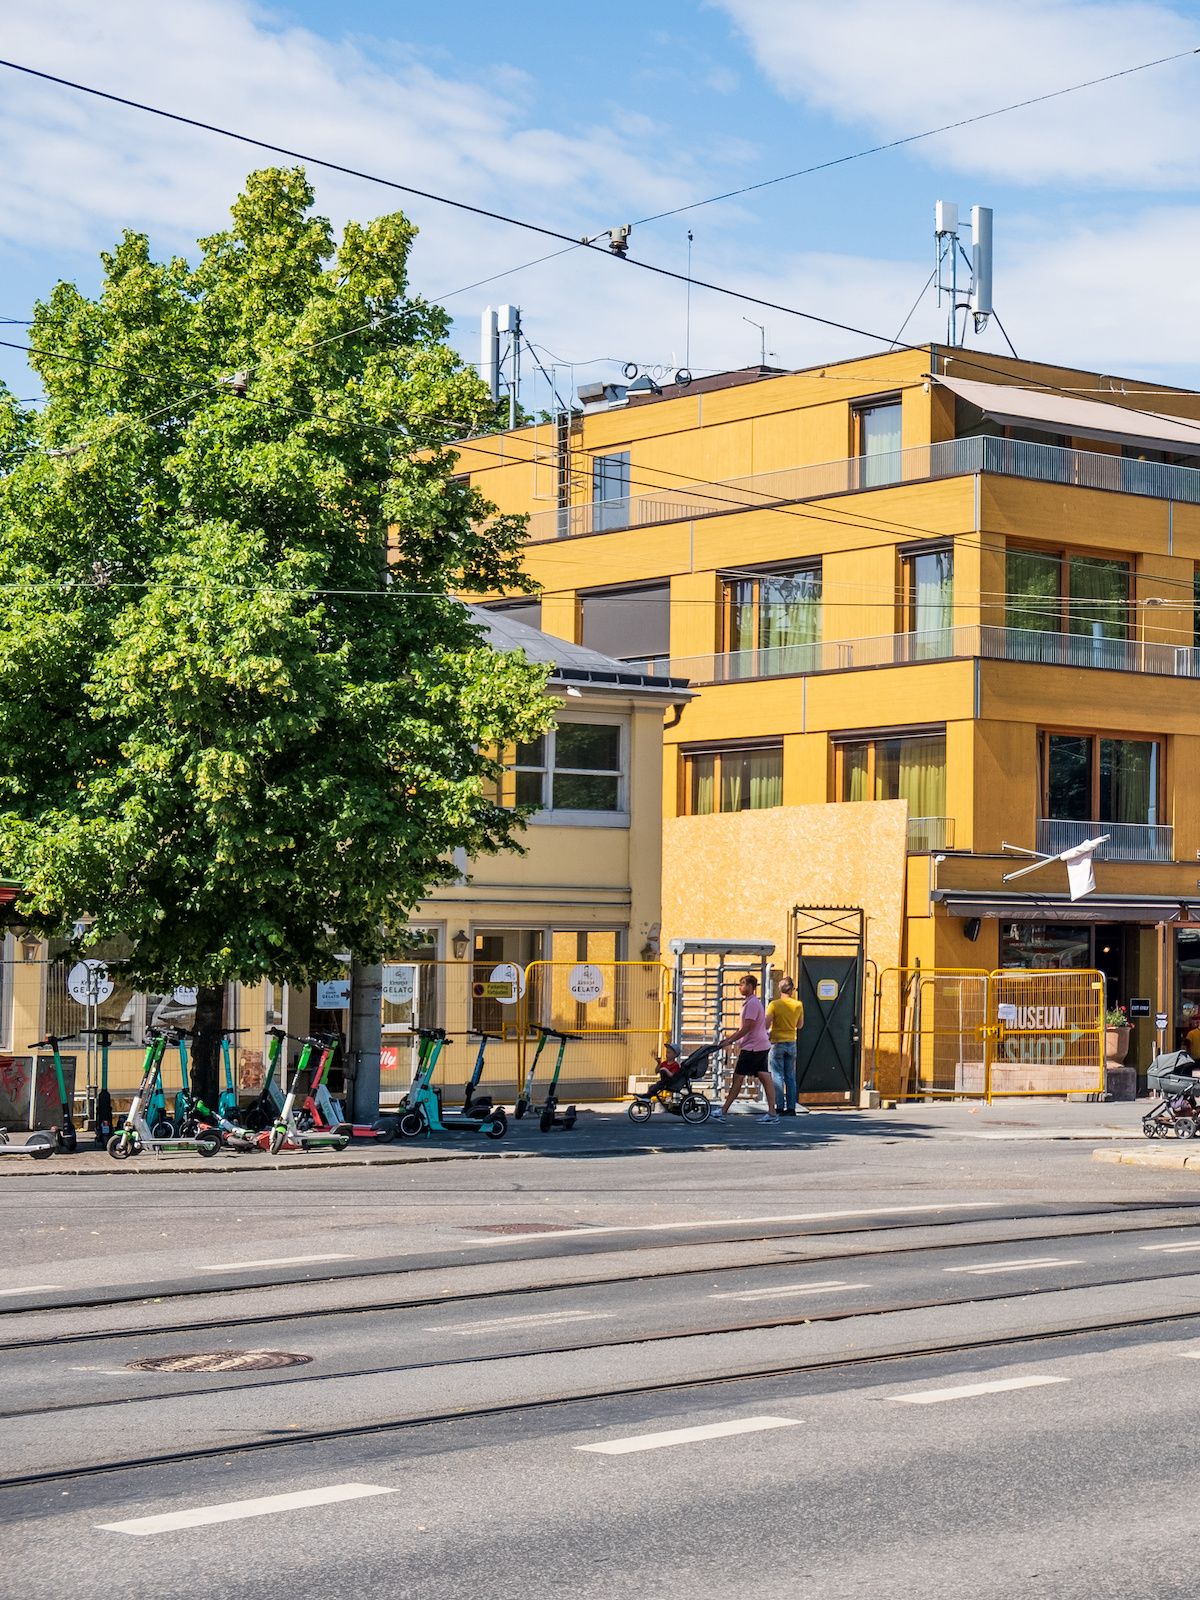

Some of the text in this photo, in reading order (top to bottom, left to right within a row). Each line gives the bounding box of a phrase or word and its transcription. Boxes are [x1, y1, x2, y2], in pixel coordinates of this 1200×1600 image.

[383, 986, 413, 994] GELATO
[380, 1050, 397, 1068] lly
[1006, 1036, 1066, 1064] SHOP
